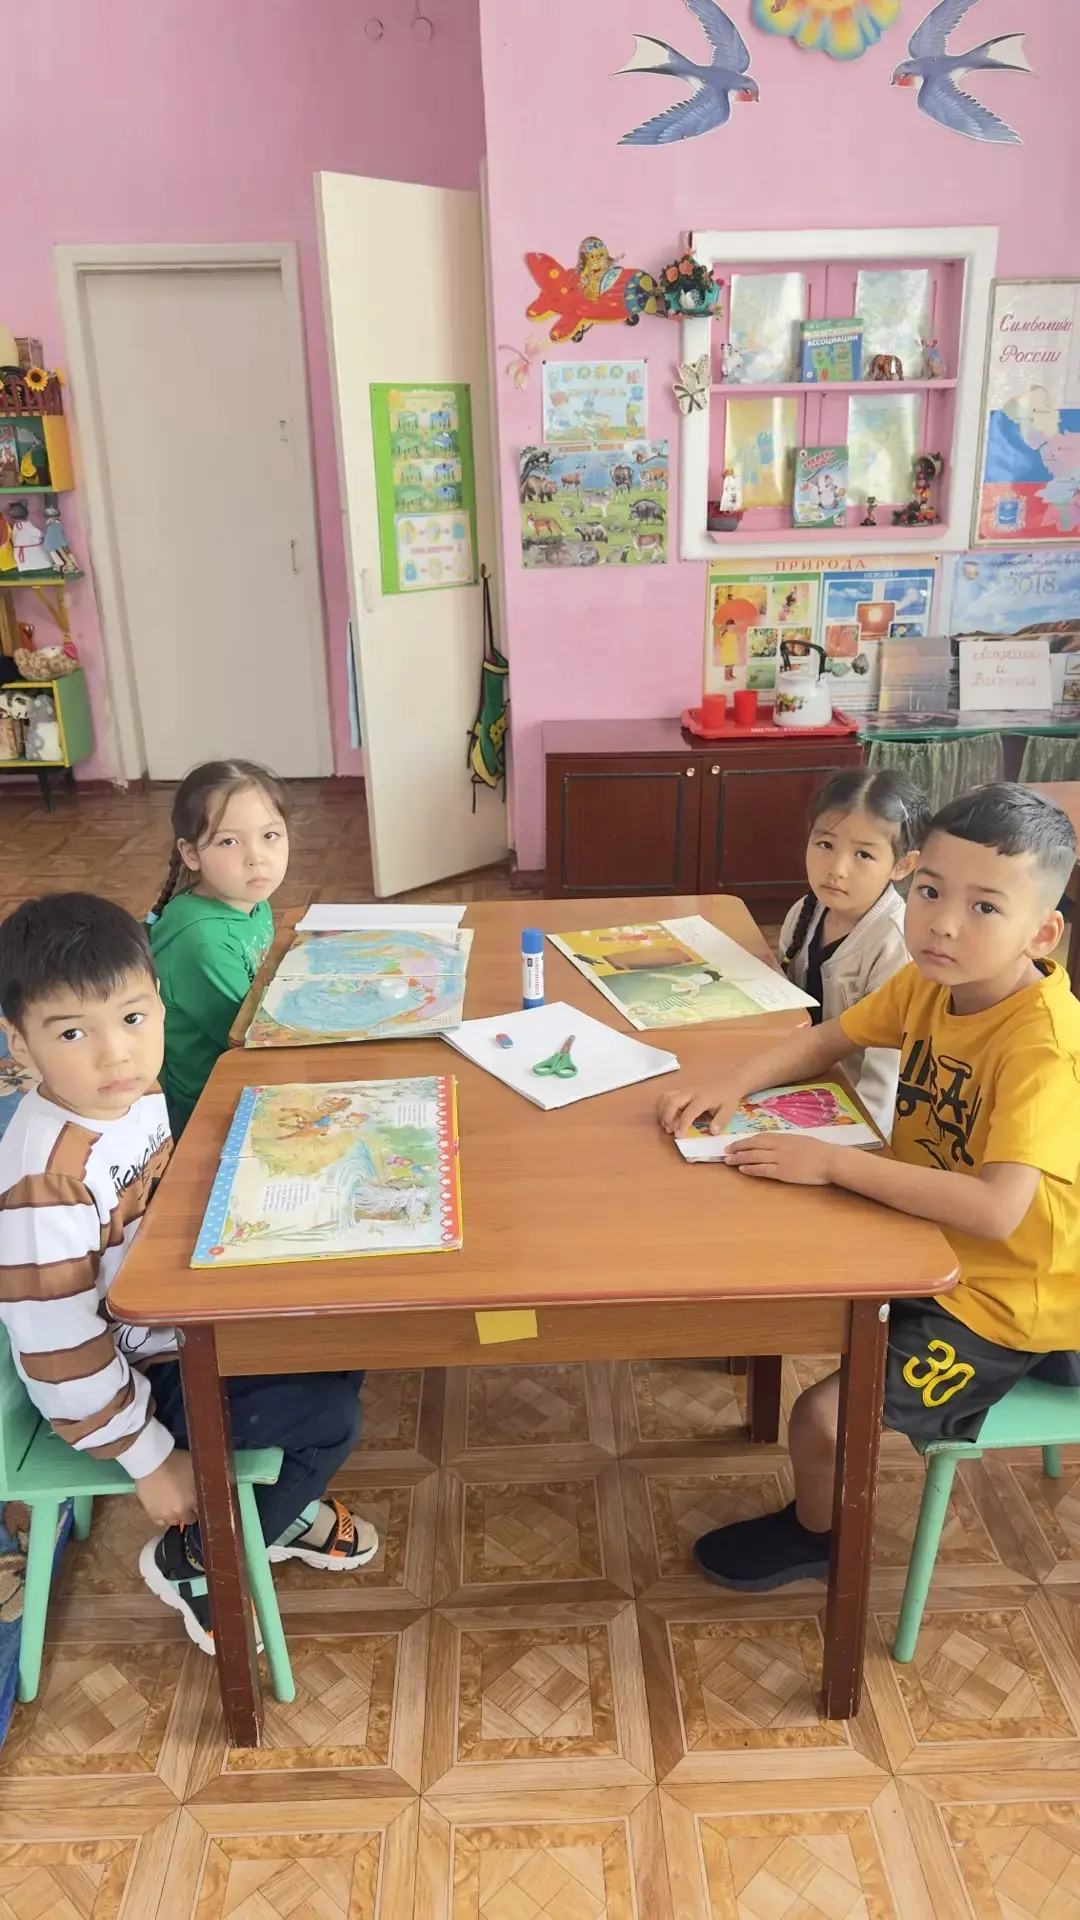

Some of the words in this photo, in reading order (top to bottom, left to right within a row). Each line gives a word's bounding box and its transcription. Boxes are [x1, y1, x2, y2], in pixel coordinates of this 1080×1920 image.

[807, 334, 859, 347] АССОЦИАЦИИ
[998, 344, 1062, 363] России
[775, 558, 867, 572] ПРИРОДА
[1004, 576, 1056, 596] 2018
[902, 1339, 976, 1408] 30
